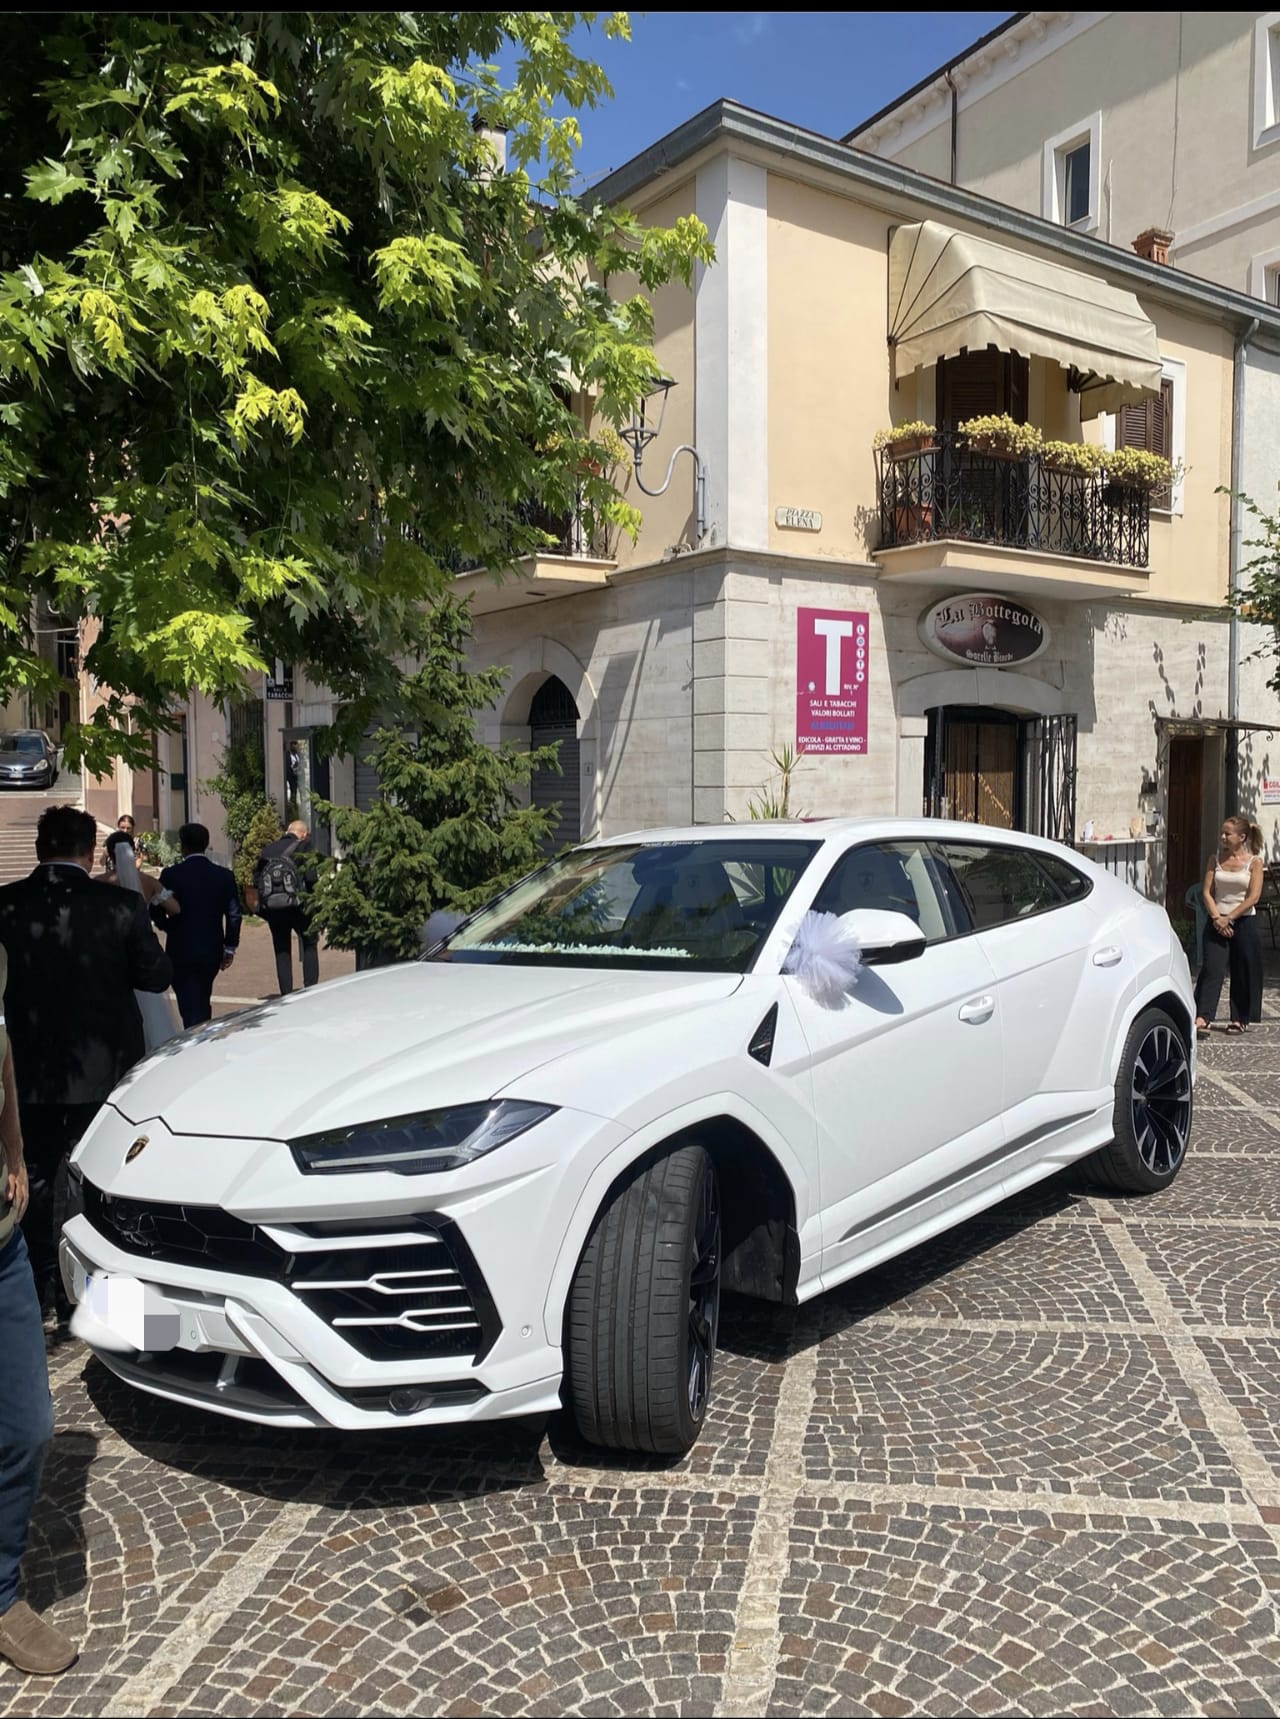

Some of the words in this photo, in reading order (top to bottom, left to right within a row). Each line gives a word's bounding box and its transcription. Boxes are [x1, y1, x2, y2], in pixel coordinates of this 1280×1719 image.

[786, 508, 814, 519] PIAZZA
[785, 516, 813, 528] ELENA
[936, 607, 965, 628] La
[969, 602, 1042, 634] Bottegola
[814, 618, 853, 696] T
[830, 700, 856, 708] TABACCHI
[832, 710, 855, 718] BOLLATI
